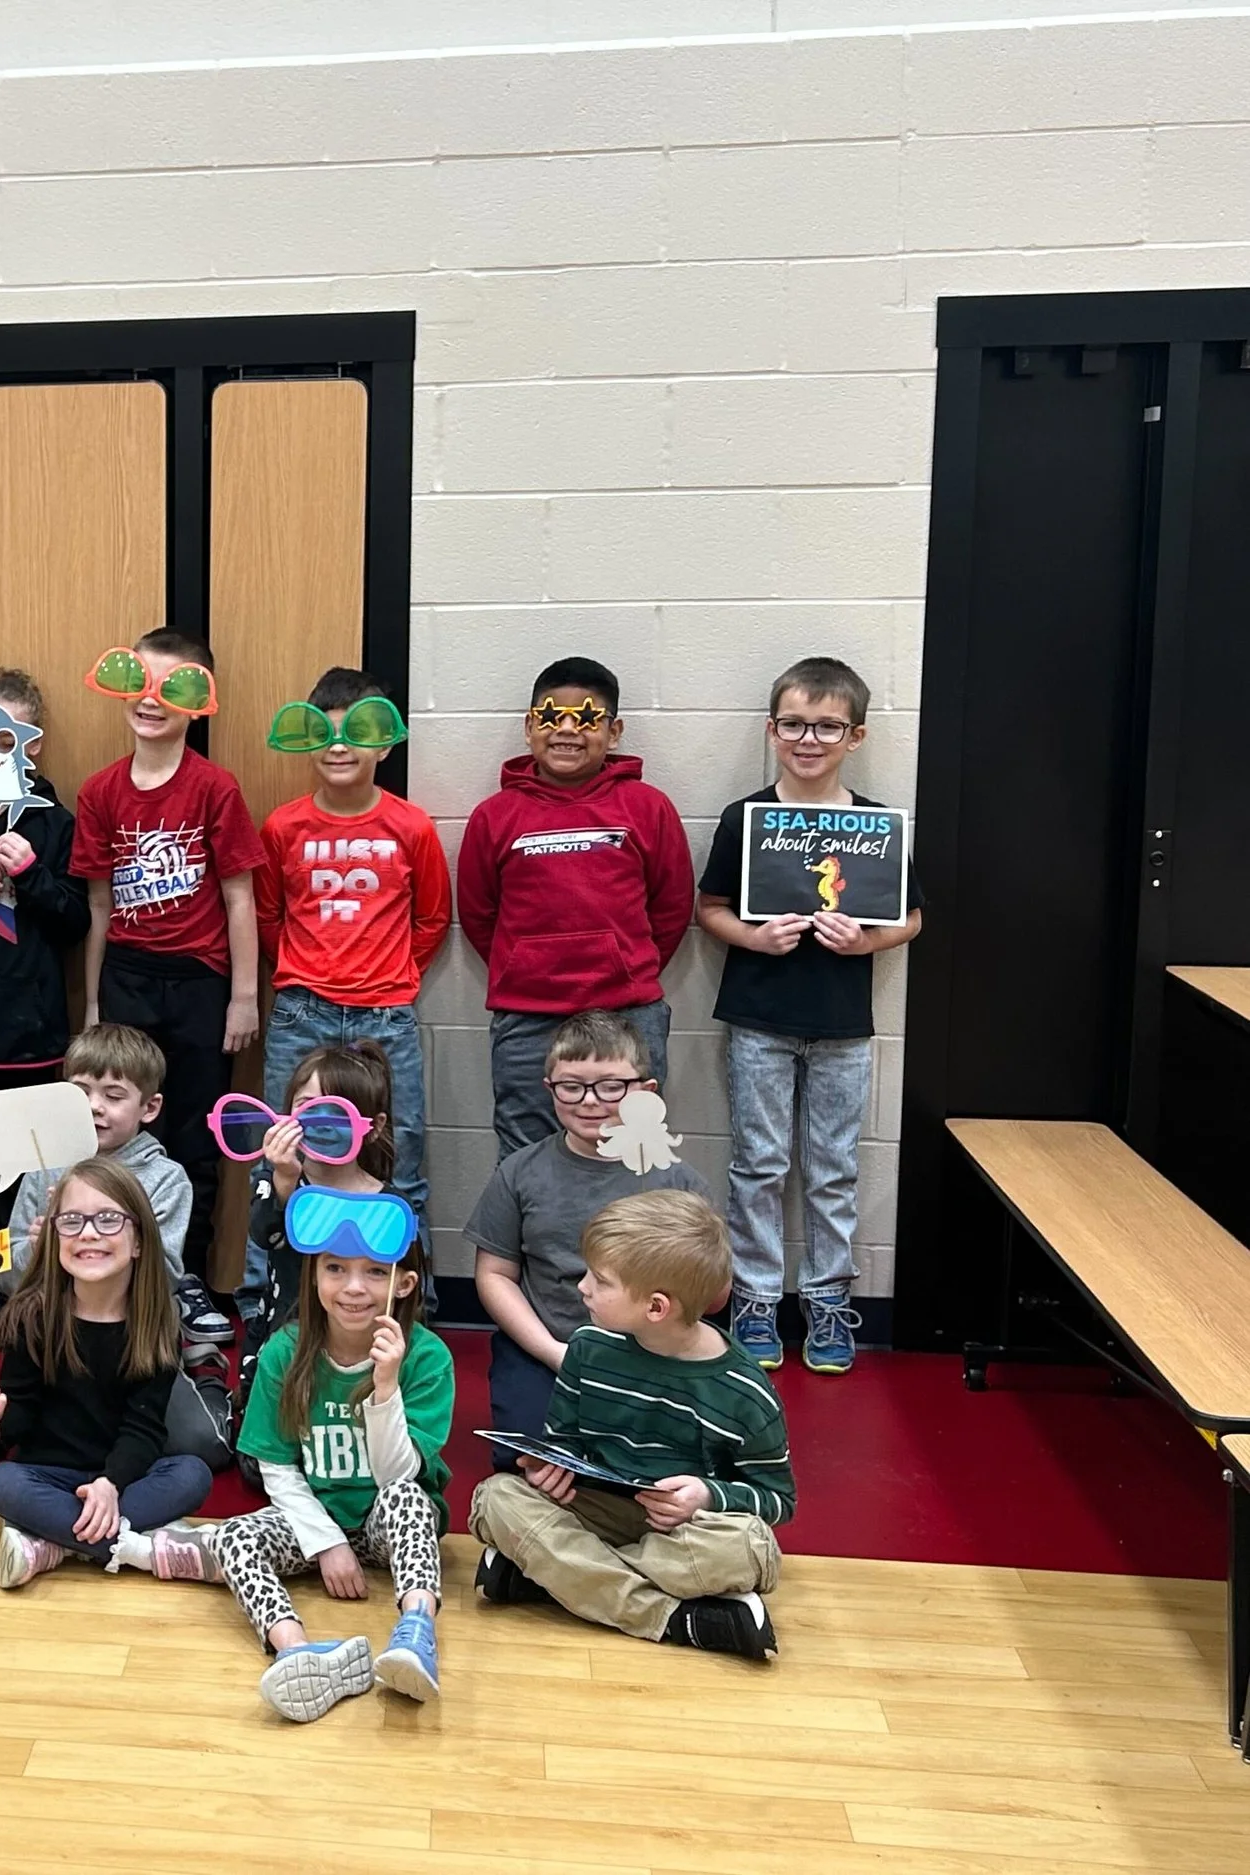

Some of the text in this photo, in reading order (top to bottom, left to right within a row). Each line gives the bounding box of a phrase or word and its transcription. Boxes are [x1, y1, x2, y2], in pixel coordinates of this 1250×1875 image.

[763, 811, 891, 834] SEA-RIOUS
[302, 838, 397, 862] JUST
[523, 841, 592, 856] PATRIOTS
[760, 828, 892, 859] about smiles!
[311, 868, 379, 895] DO
[319, 899, 361, 924] IT
